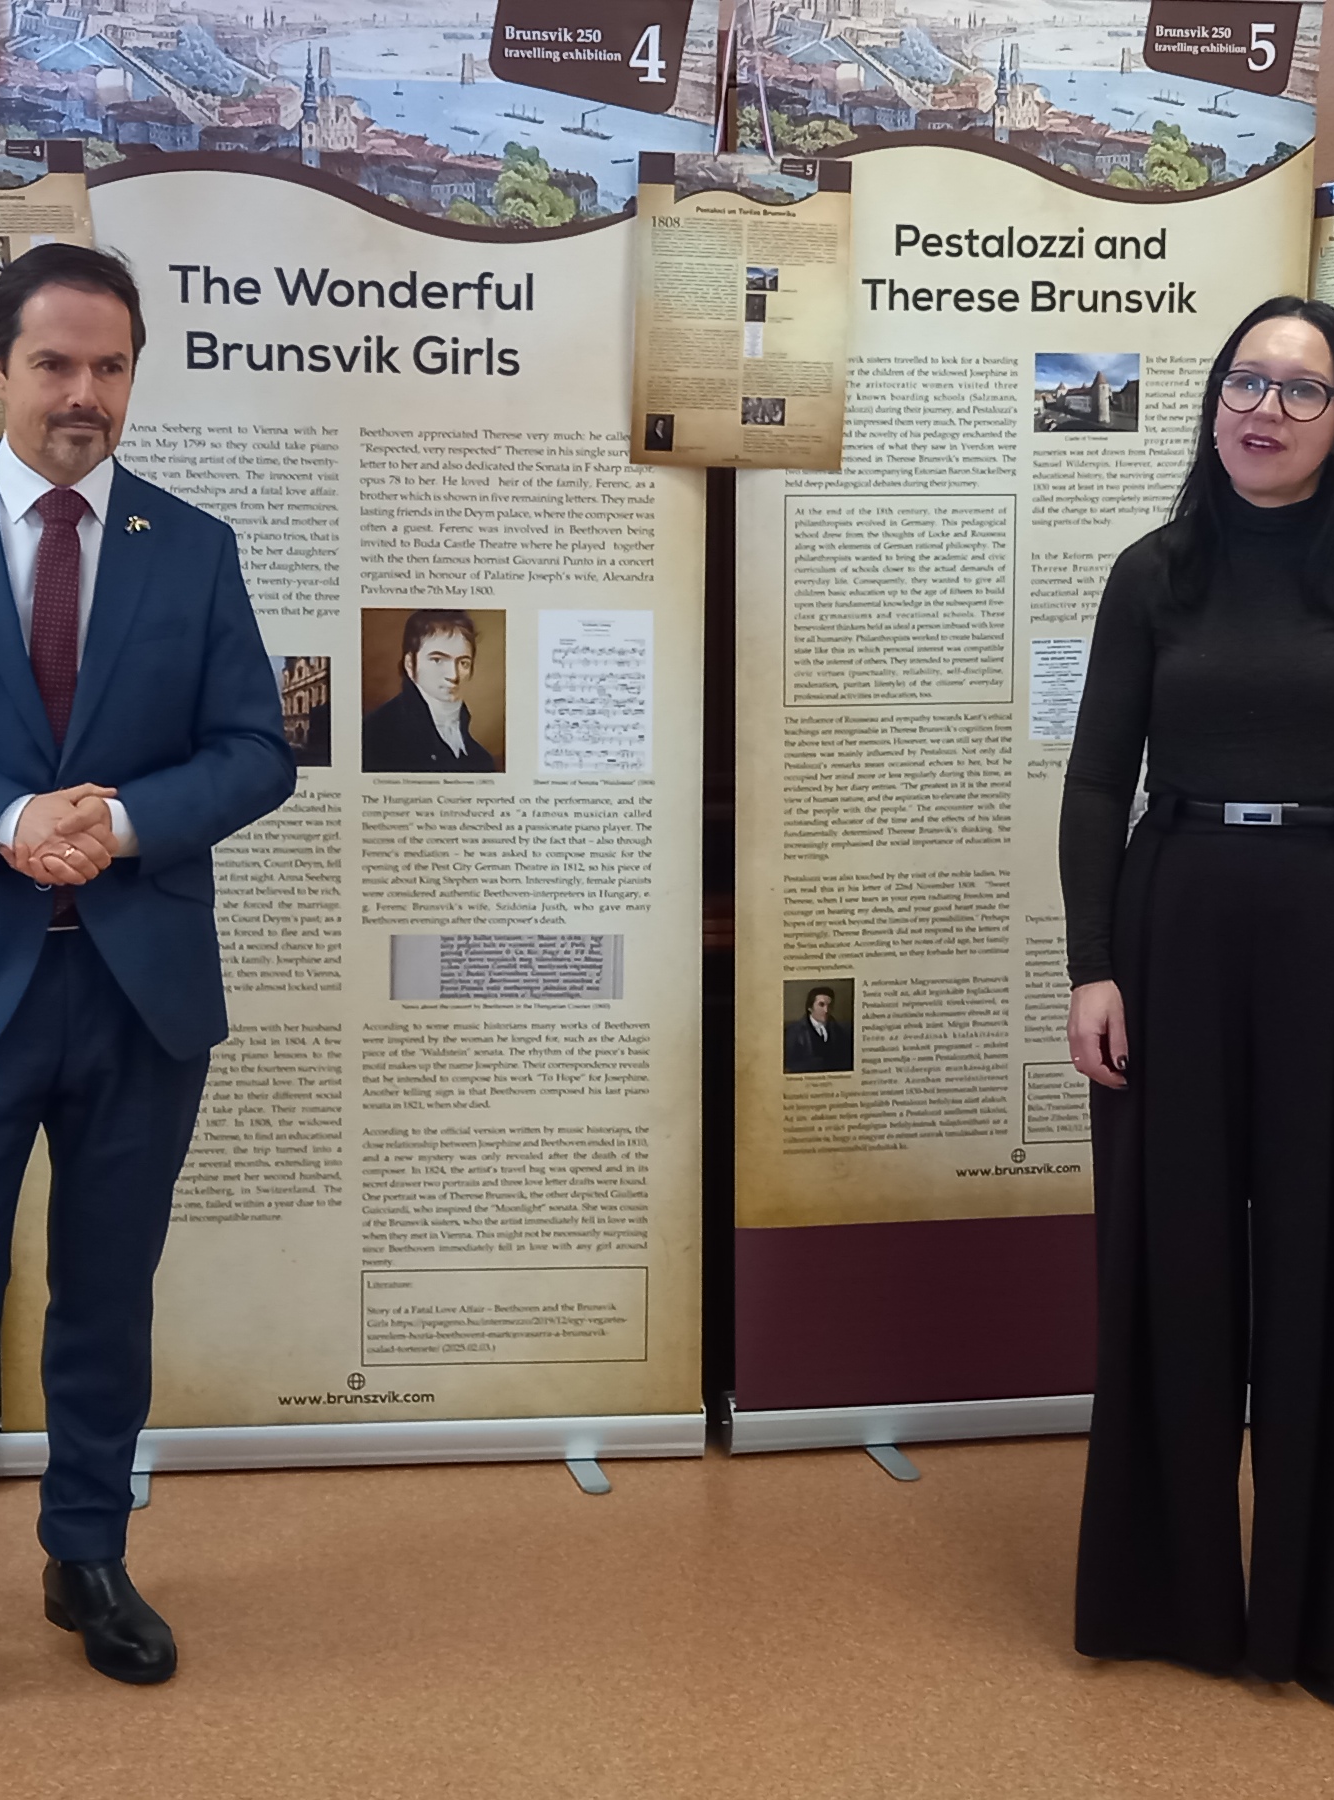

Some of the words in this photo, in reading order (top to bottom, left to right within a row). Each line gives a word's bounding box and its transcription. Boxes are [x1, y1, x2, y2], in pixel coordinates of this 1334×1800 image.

[504, 25, 574, 43] Brunsvik
[576, 28, 602, 43] 250
[1155, 24, 1210, 39] Brunsvik
[1211, 26, 1232, 39] 250
[504, 46, 561, 63] travelling
[562, 48, 622, 62] exhibition
[628, 24, 667, 84] 4
[1154, 41, 1199, 55] travelling
[1200, 42, 1247, 54] exhibition
[1247, 22, 1276, 72] 5
[805, 163, 814, 176] 5
[894, 223, 1085, 259] Pestalozzi
[1094, 227, 1167, 260] and
[168, 264, 262, 306] The
[273, 266, 534, 311] Wonderful
[861, 278, 1020, 313] Therese
[1030, 280, 1197, 314] Brunsvik
[186, 330, 402, 374] Brunsvik
[412, 335, 520, 377] Girls
[237, 425, 248, 434] to
[321, 425, 338, 436] her
[588, 430, 602, 441] he
[409, 583, 425, 595] the
[427, 584, 444, 595] 7th
[445, 584, 467, 598] May
[955, 1162, 1081, 1178] www.brunszvik.com
[277, 1390, 435, 1406] www.brunszvik.com
